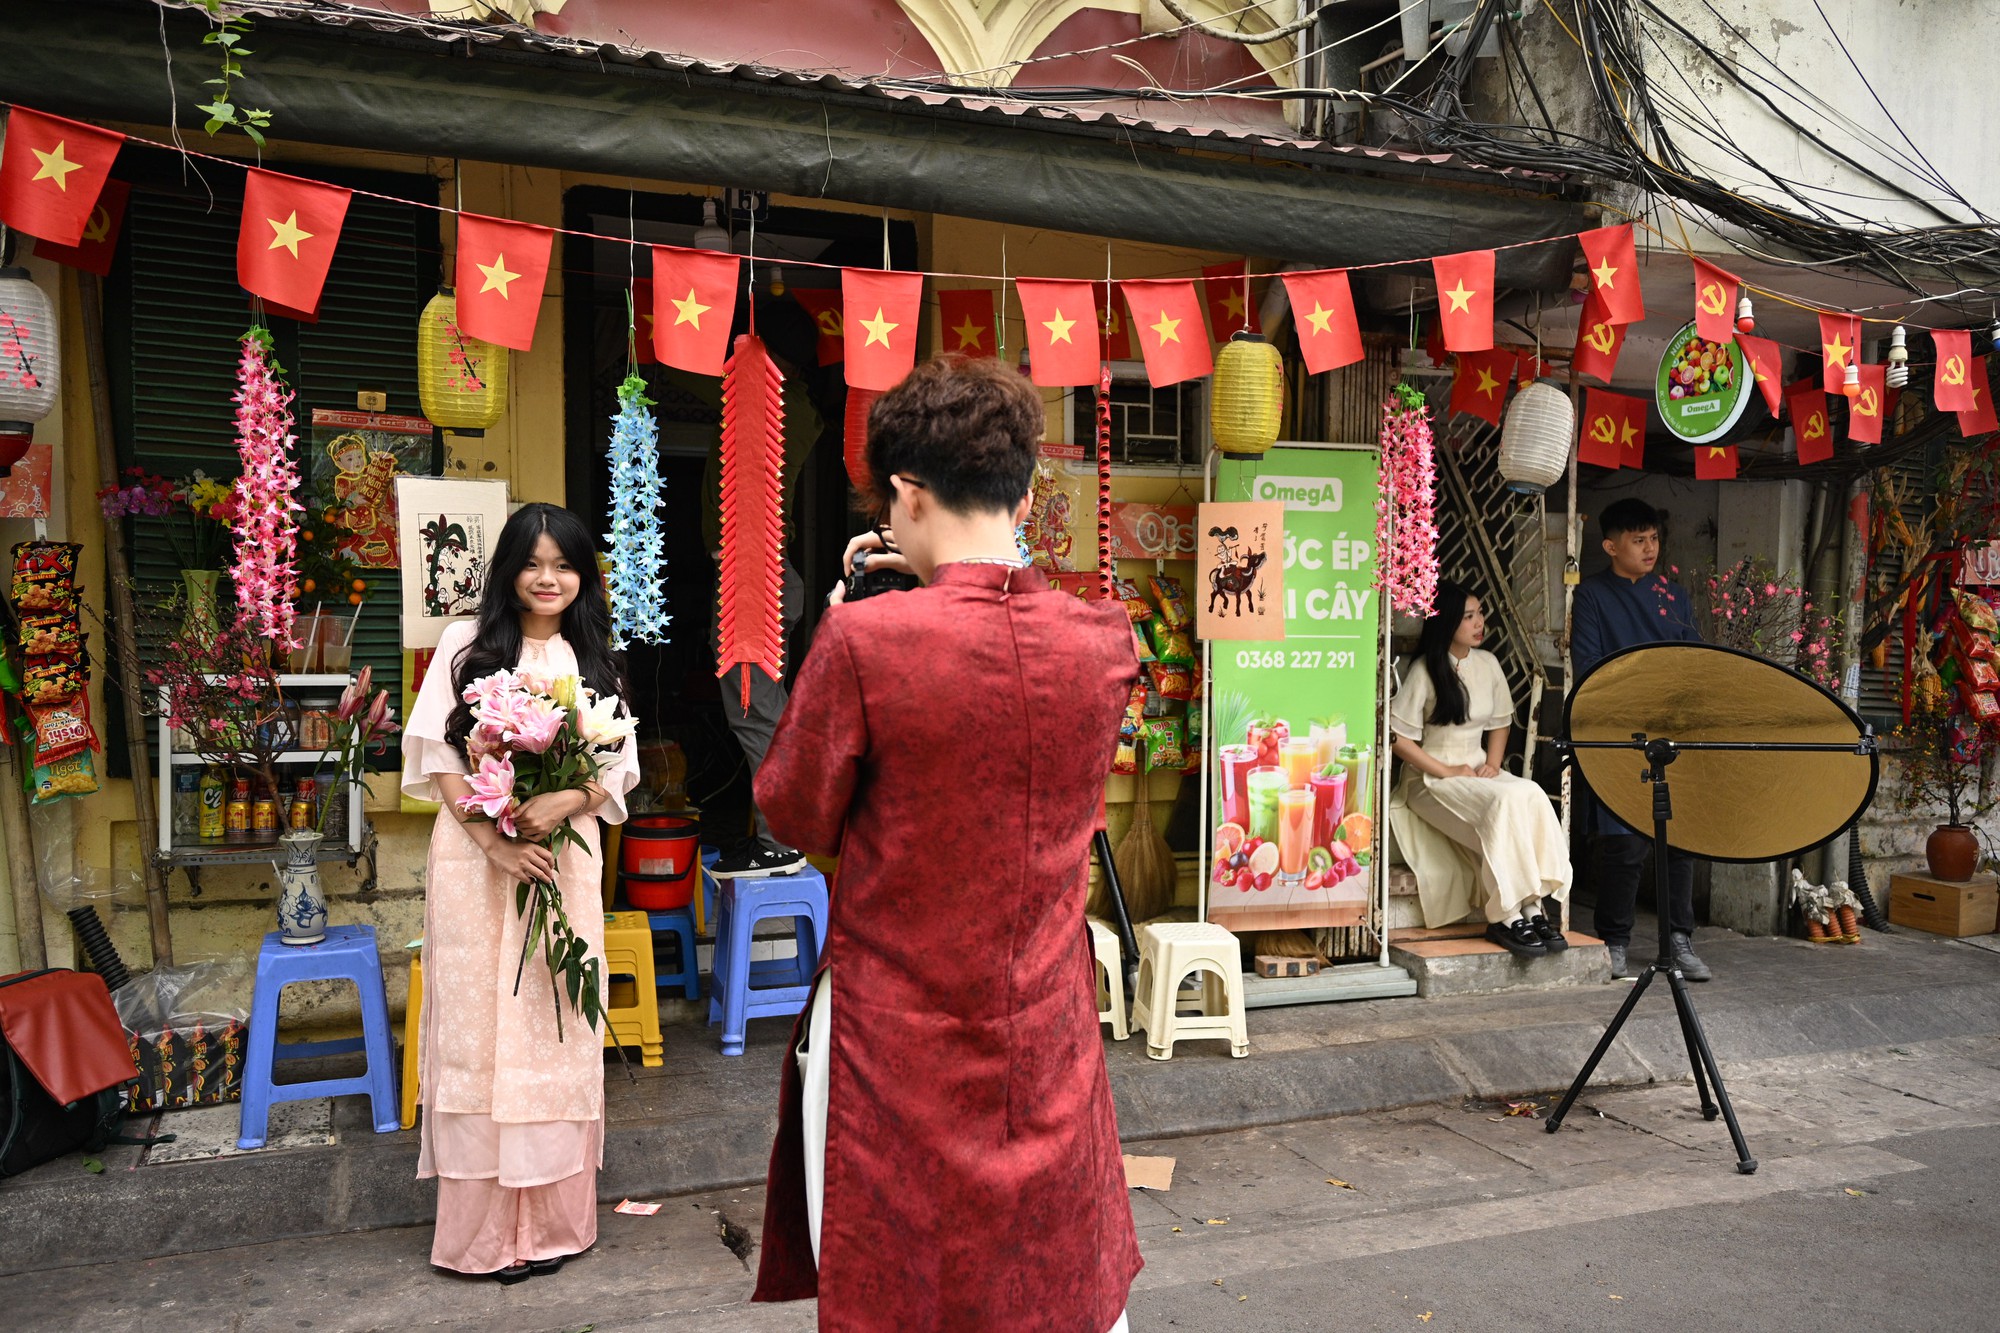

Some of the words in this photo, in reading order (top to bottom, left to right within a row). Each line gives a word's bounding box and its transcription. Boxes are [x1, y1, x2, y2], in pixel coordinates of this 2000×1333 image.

[1687, 402, 1715, 413] OmegA
[1260, 482, 1336, 506] OmegA
[1136, 512, 1198, 552] Ois
[1332, 531, 1371, 570] ÉP
[1305, 581, 1371, 620] CÂY
[1236, 650, 1285, 669] 0368
[1290, 651, 1322, 669] 227
[1326, 651, 1355, 668] 291
[48, 724, 87, 743] Oishi
[204, 788, 222, 808] C2
